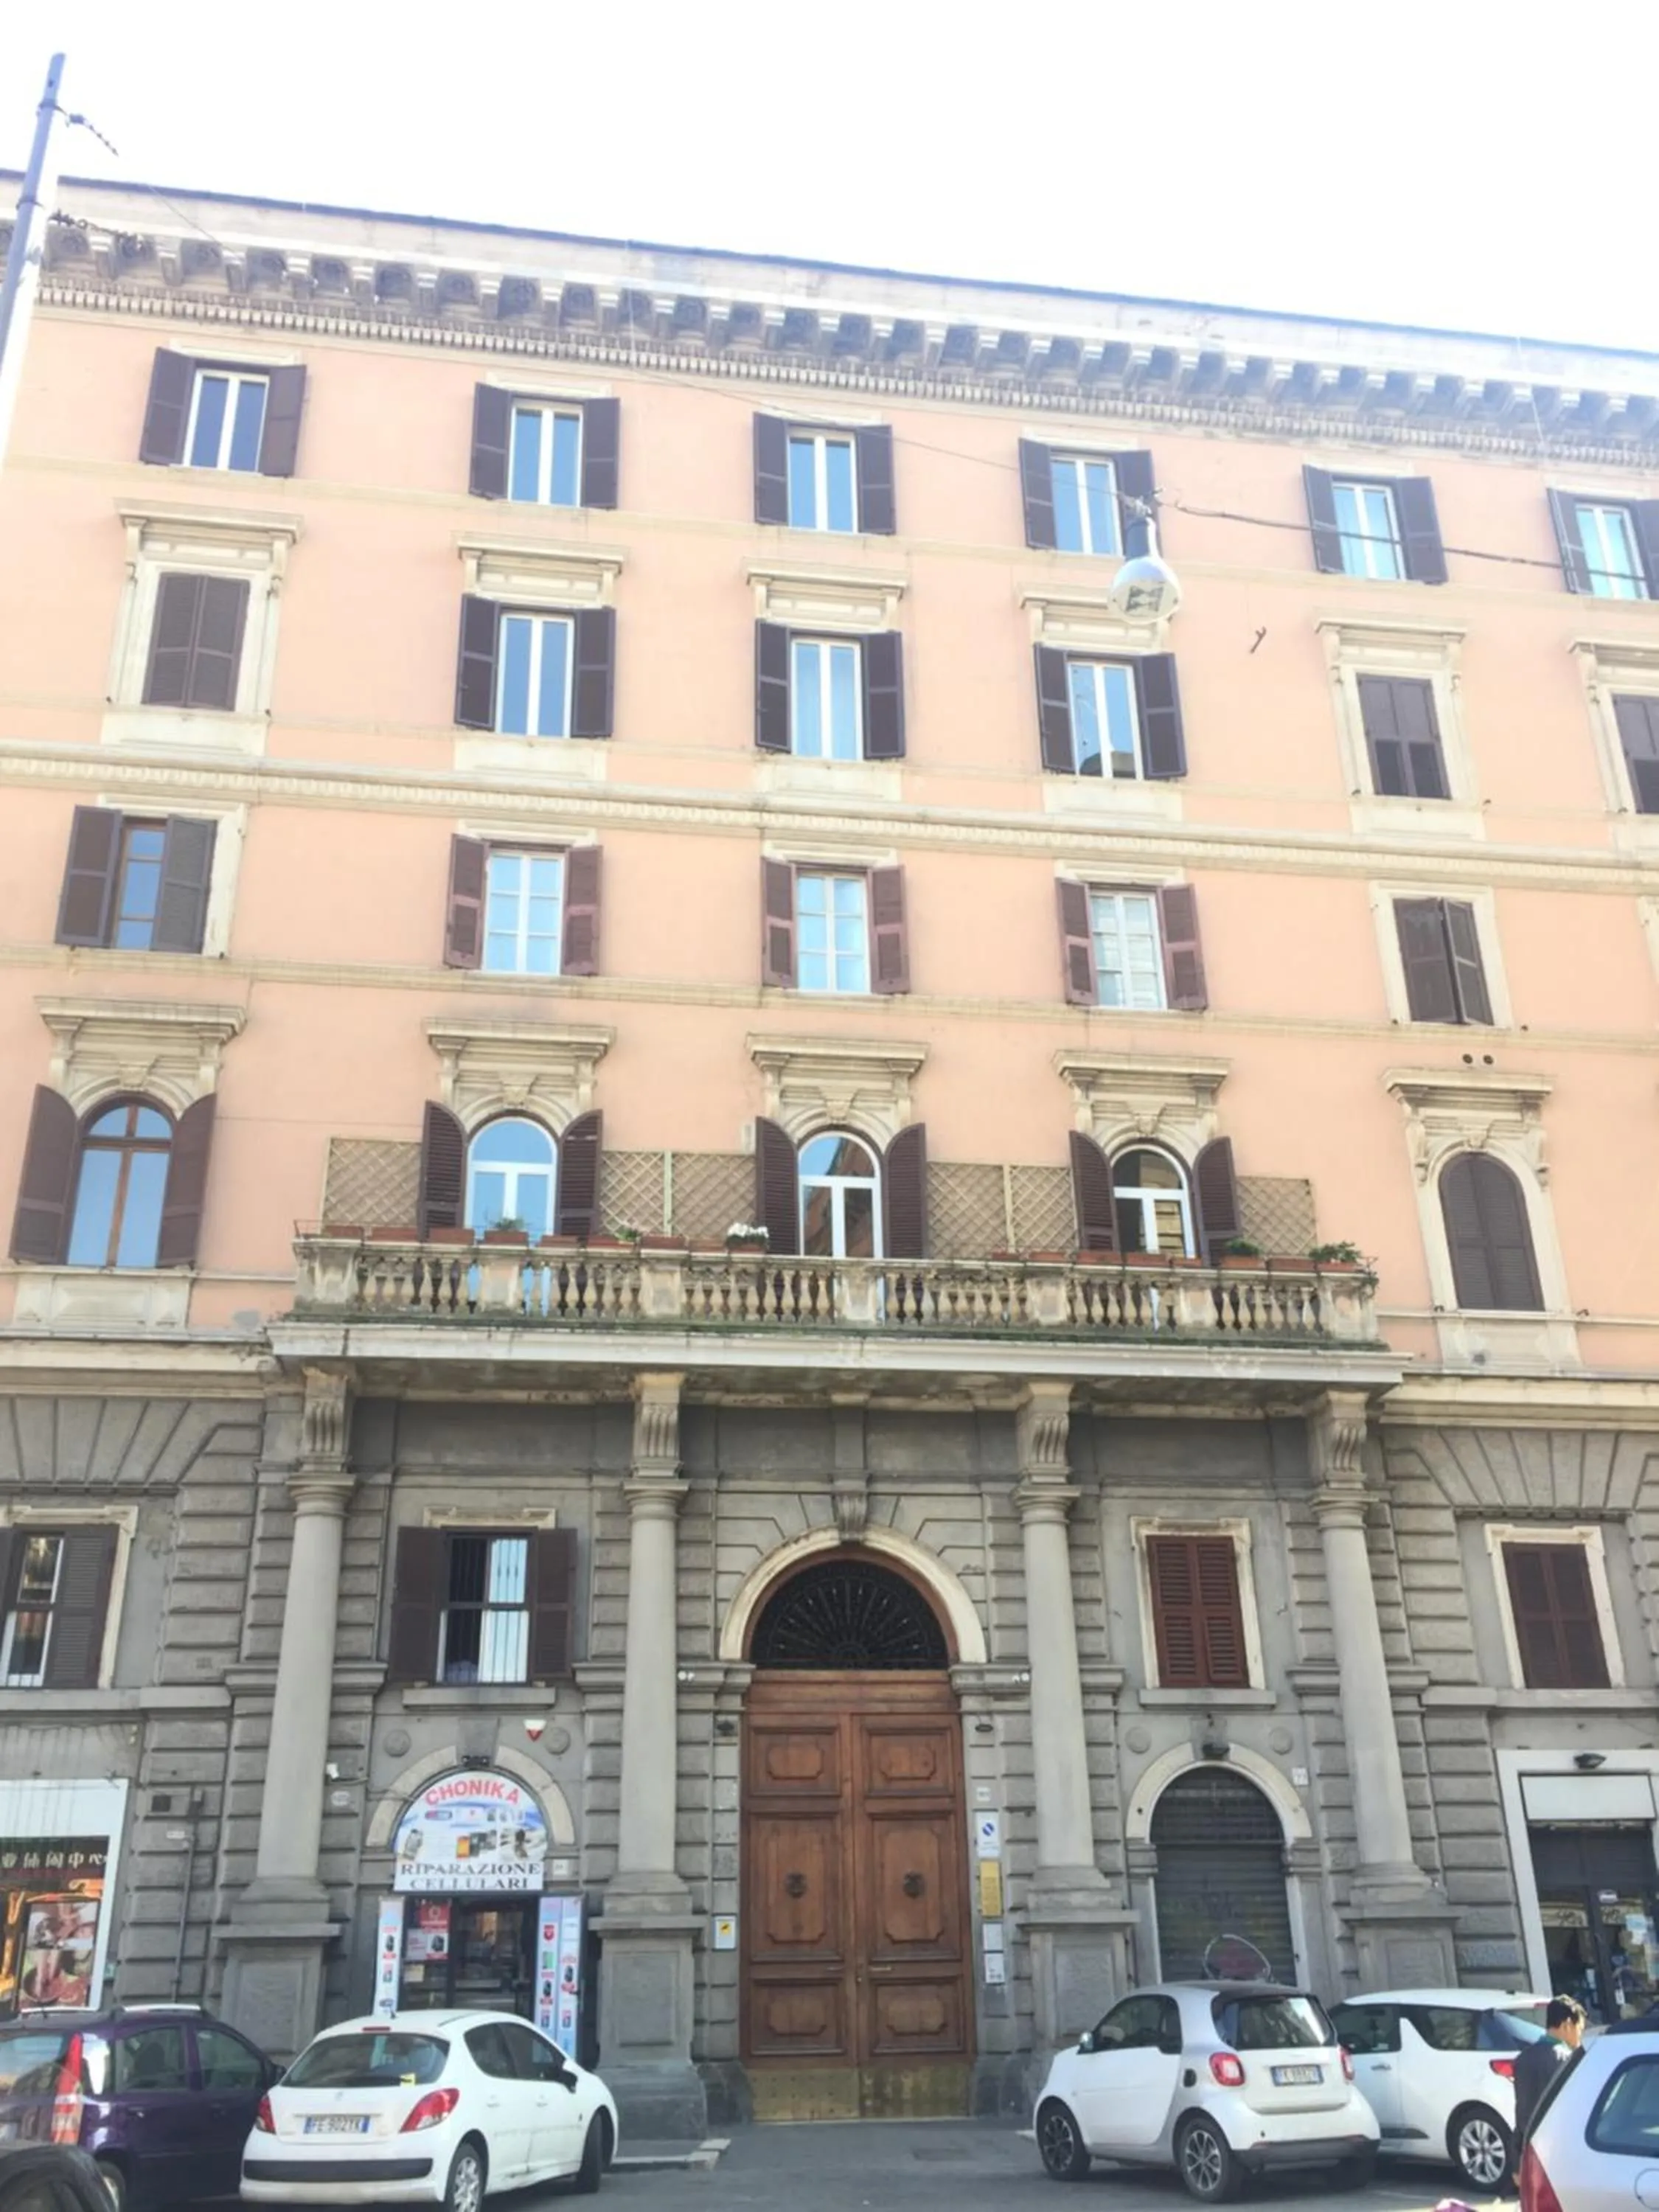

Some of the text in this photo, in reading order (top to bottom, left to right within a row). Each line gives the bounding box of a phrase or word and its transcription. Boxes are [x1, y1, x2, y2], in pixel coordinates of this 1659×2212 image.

[425, 1780, 520, 1806] CHONIKA
[401, 1863, 540, 1875] RIPARAZIONE
[410, 1878, 529, 1889] CELLULARI
